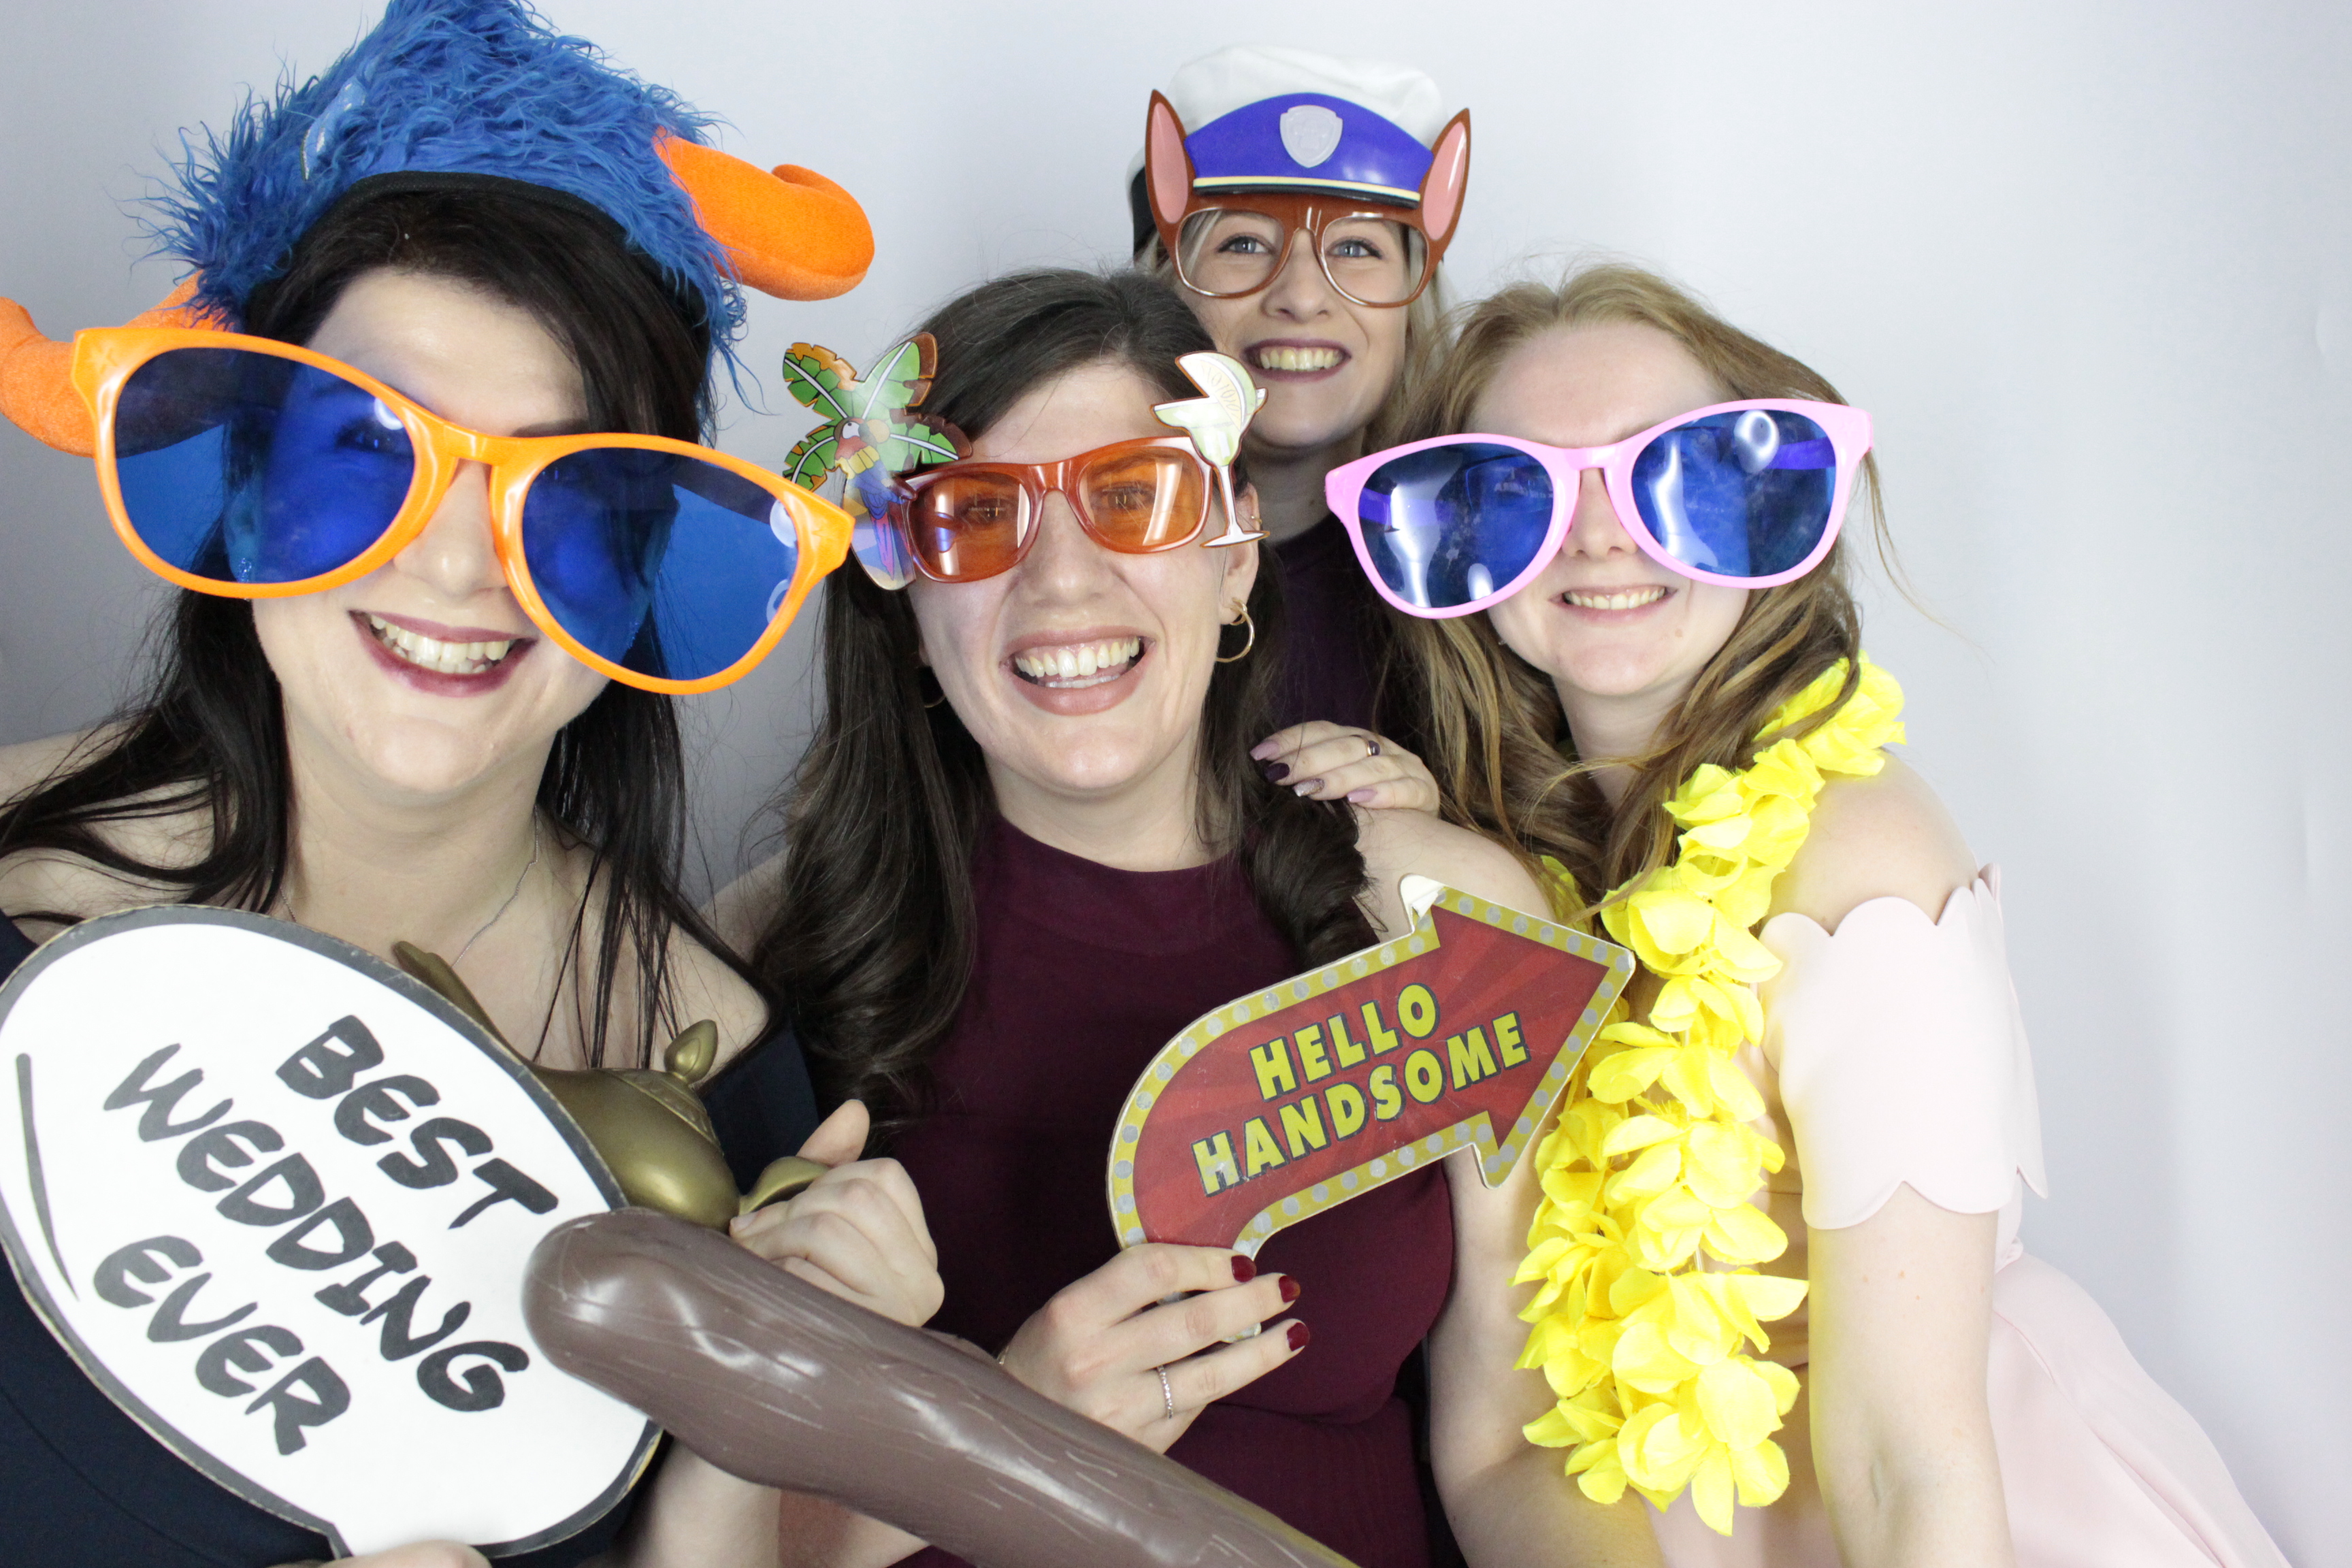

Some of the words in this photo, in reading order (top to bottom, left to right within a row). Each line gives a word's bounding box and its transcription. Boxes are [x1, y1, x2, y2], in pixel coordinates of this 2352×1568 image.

[276, 1015, 558, 1229] BEST
[1192, 1013, 1530, 1196] HANDSOME
[1250, 984, 1440, 1100] HELLO
[103, 1044, 529, 1412] WEDDING
[94, 1236, 350, 1455] EVER
